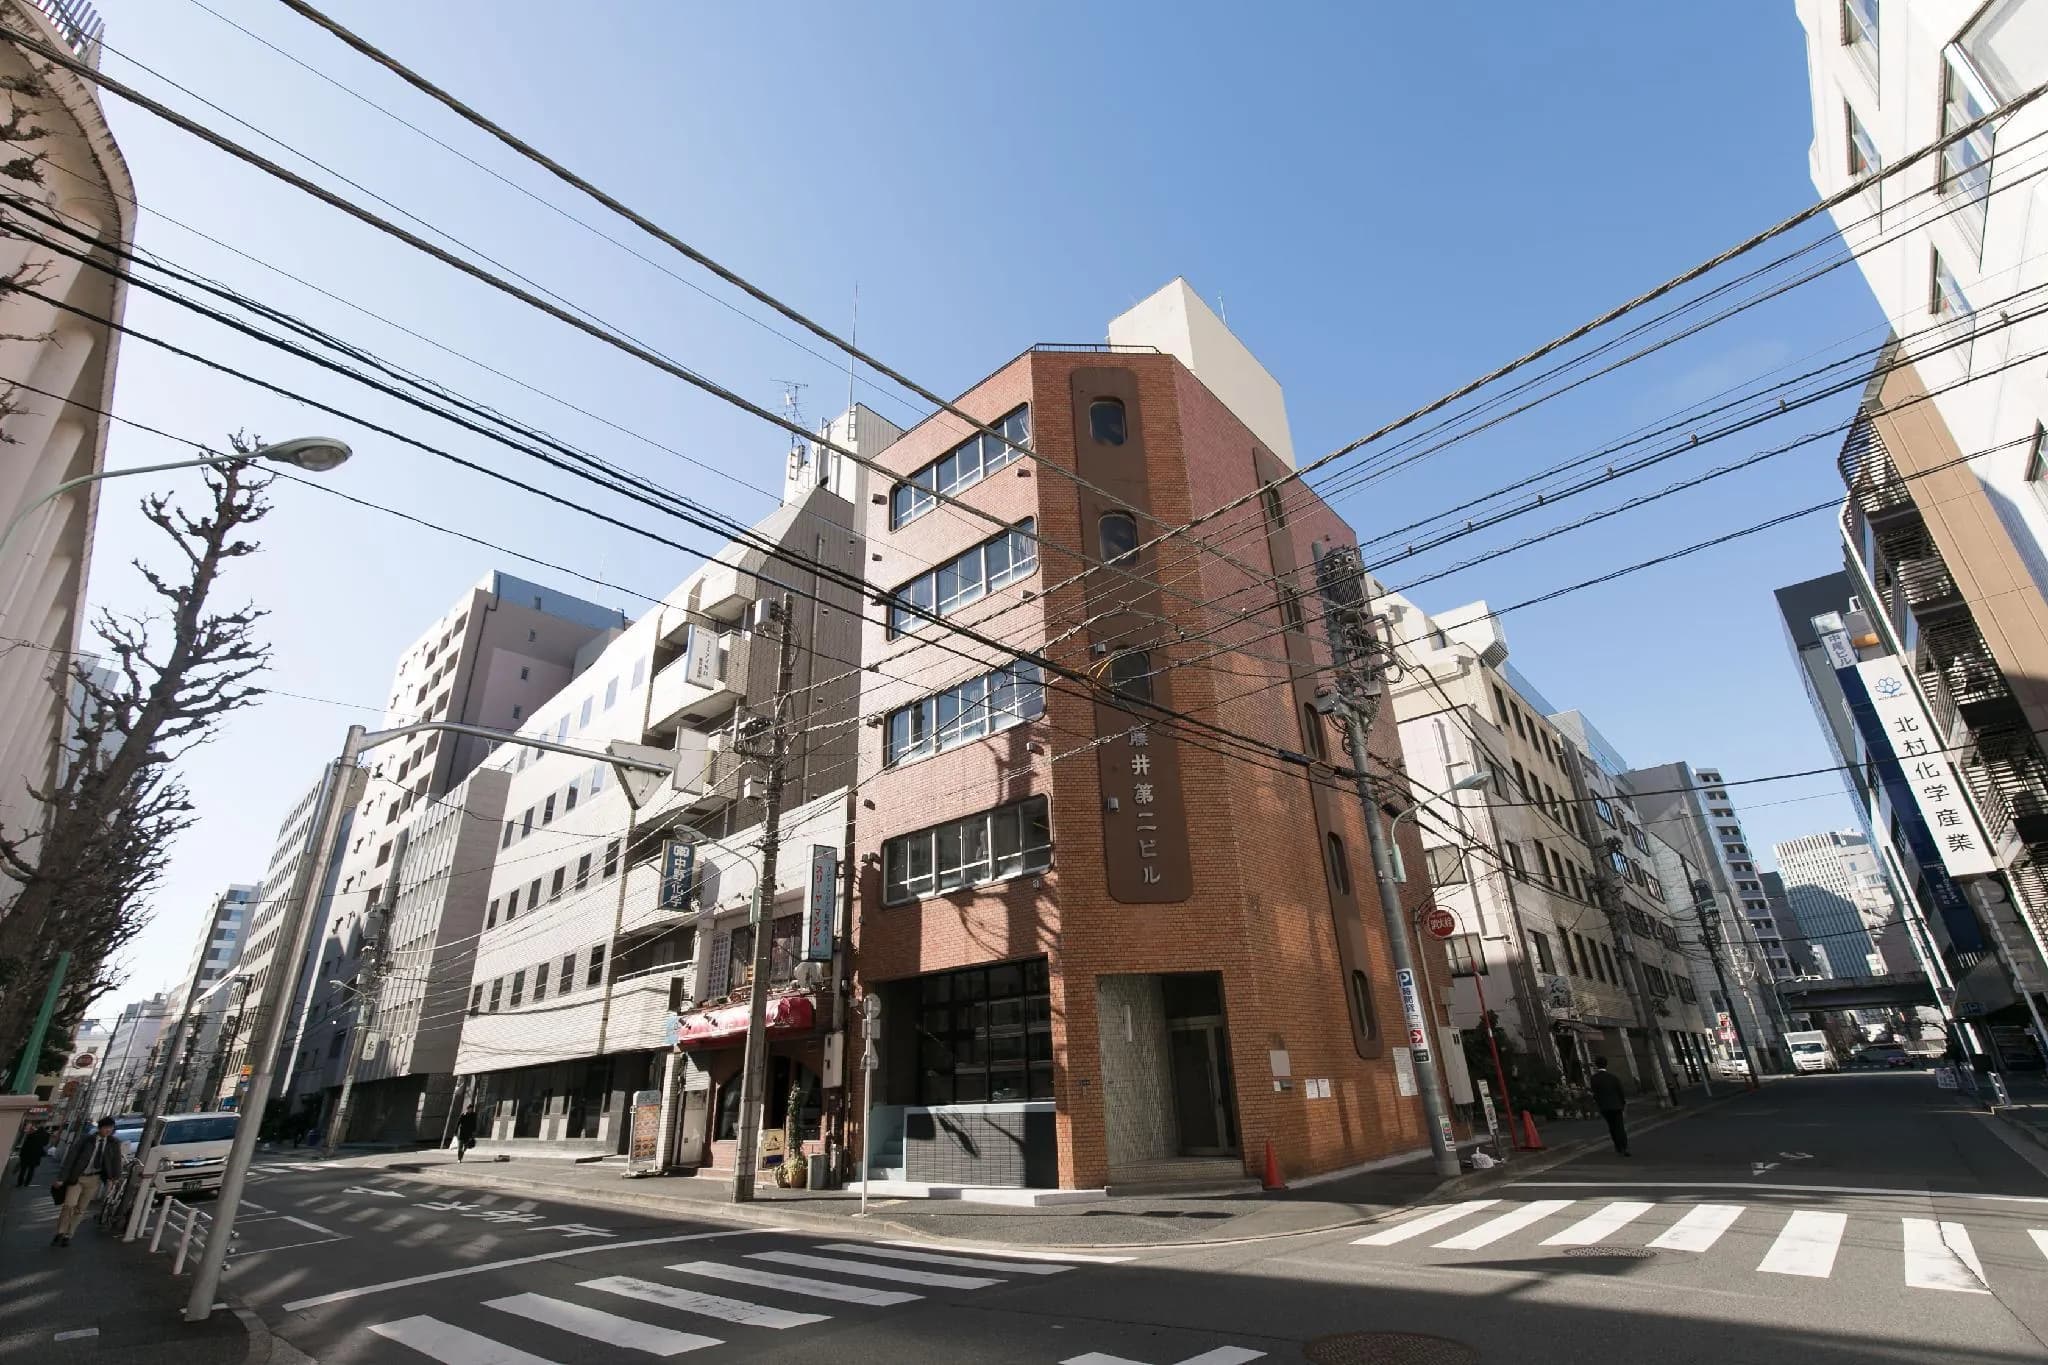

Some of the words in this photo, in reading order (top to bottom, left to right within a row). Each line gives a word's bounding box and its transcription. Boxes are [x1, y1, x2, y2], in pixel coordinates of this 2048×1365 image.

[1128, 725, 1161, 885] 藤井第二ビル
[1894, 715, 1975, 853] 北村化学産業
[670, 857, 687, 907] 中野化学
